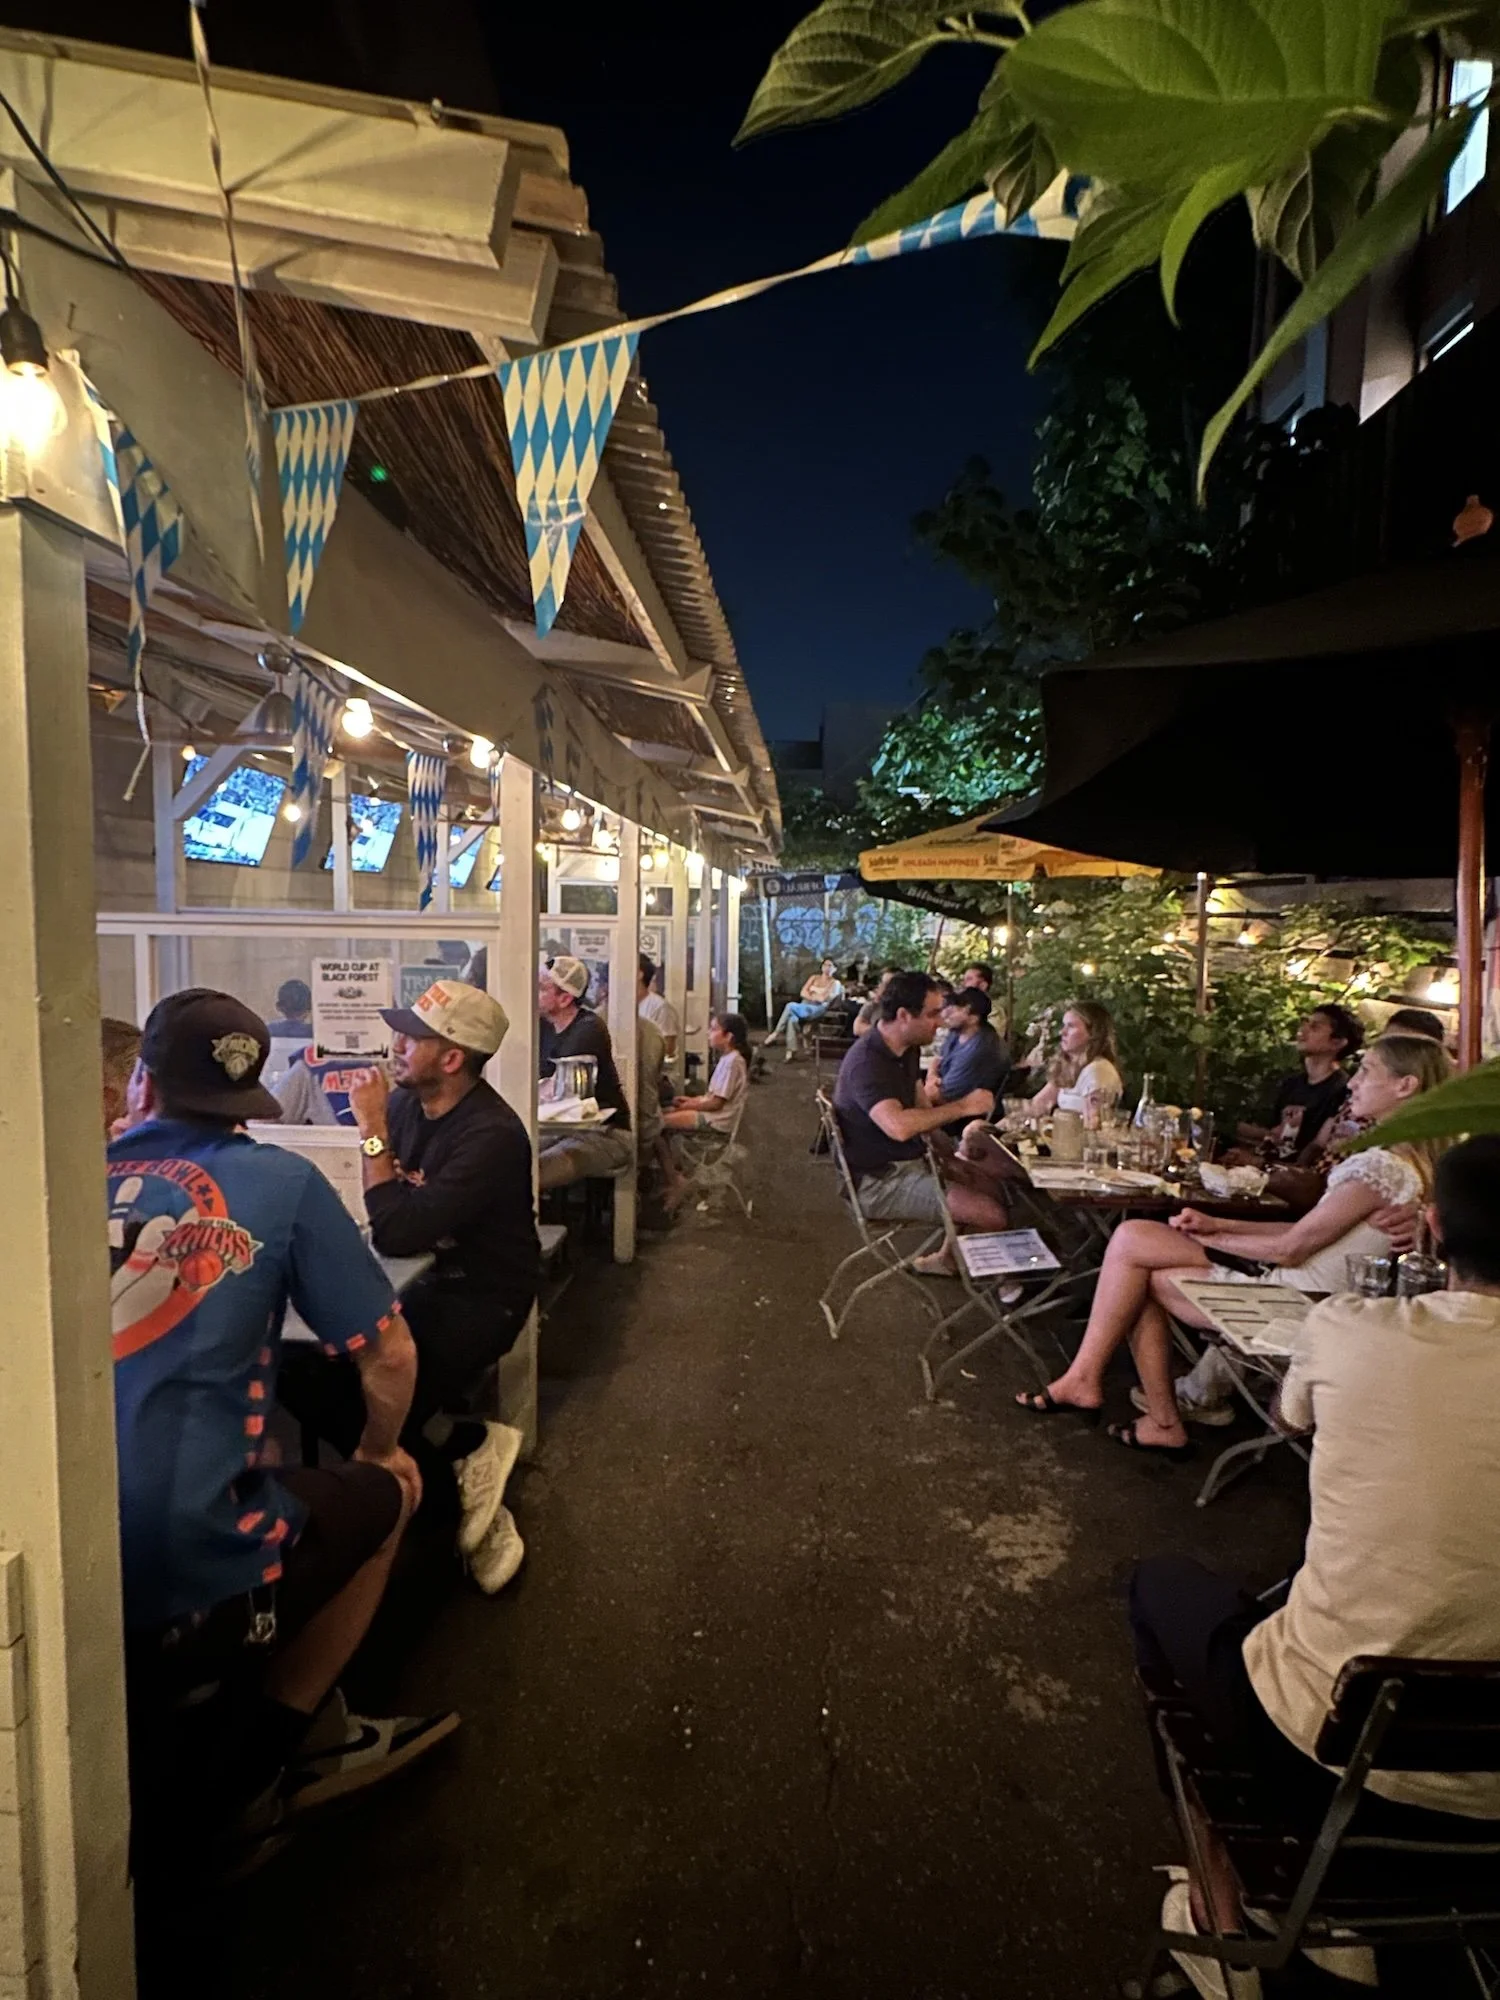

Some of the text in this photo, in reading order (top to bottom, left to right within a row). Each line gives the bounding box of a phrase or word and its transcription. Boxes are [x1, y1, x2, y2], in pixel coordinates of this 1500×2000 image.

[320, 962, 380, 972] WORLD CUP AT
[322, 972, 379, 982] BLACK FOREST
[144, 1160, 202, 1192] BOWL
[163, 1222, 251, 1266] KNICKS
